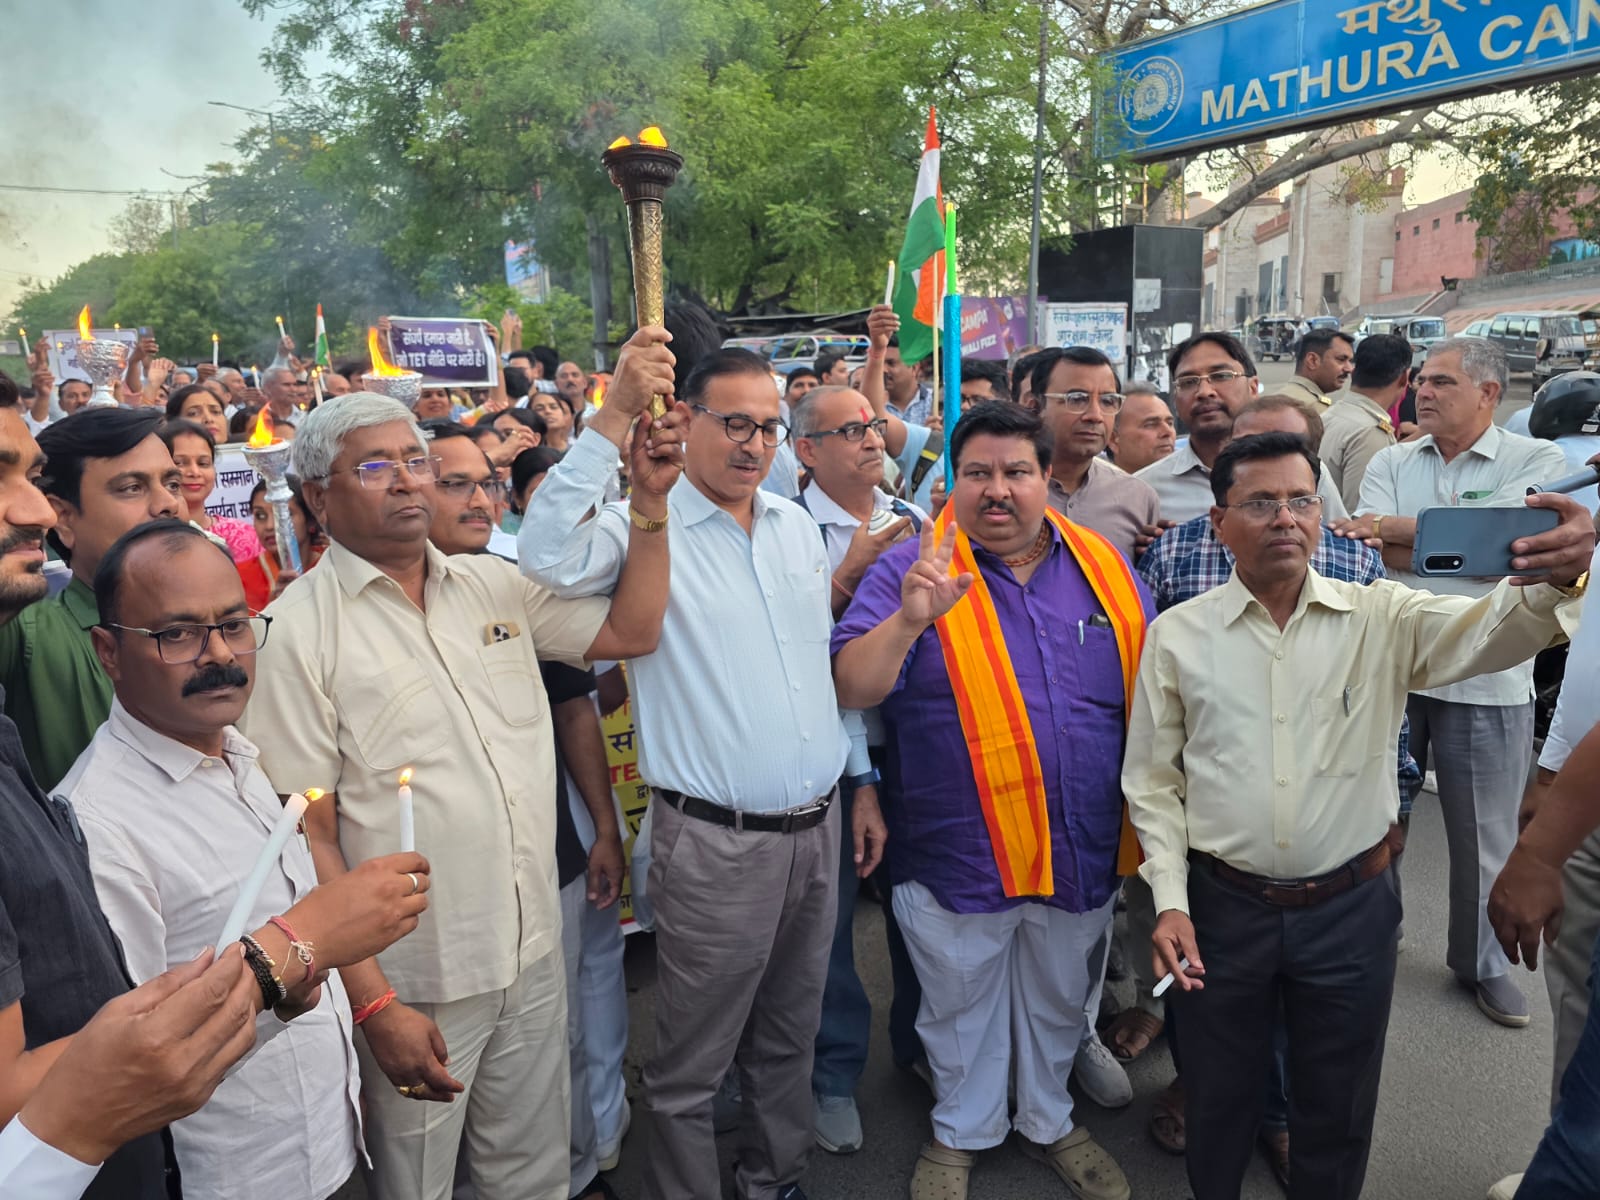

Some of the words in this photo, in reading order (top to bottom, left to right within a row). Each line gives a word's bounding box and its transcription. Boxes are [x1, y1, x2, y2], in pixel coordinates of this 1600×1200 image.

[1201, 31, 1460, 126] MATHURA
[408, 351, 426, 367] TET
[446, 353, 458, 367] पर
[219, 469, 255, 488] सम्मान
[608, 762, 641, 784] TE
